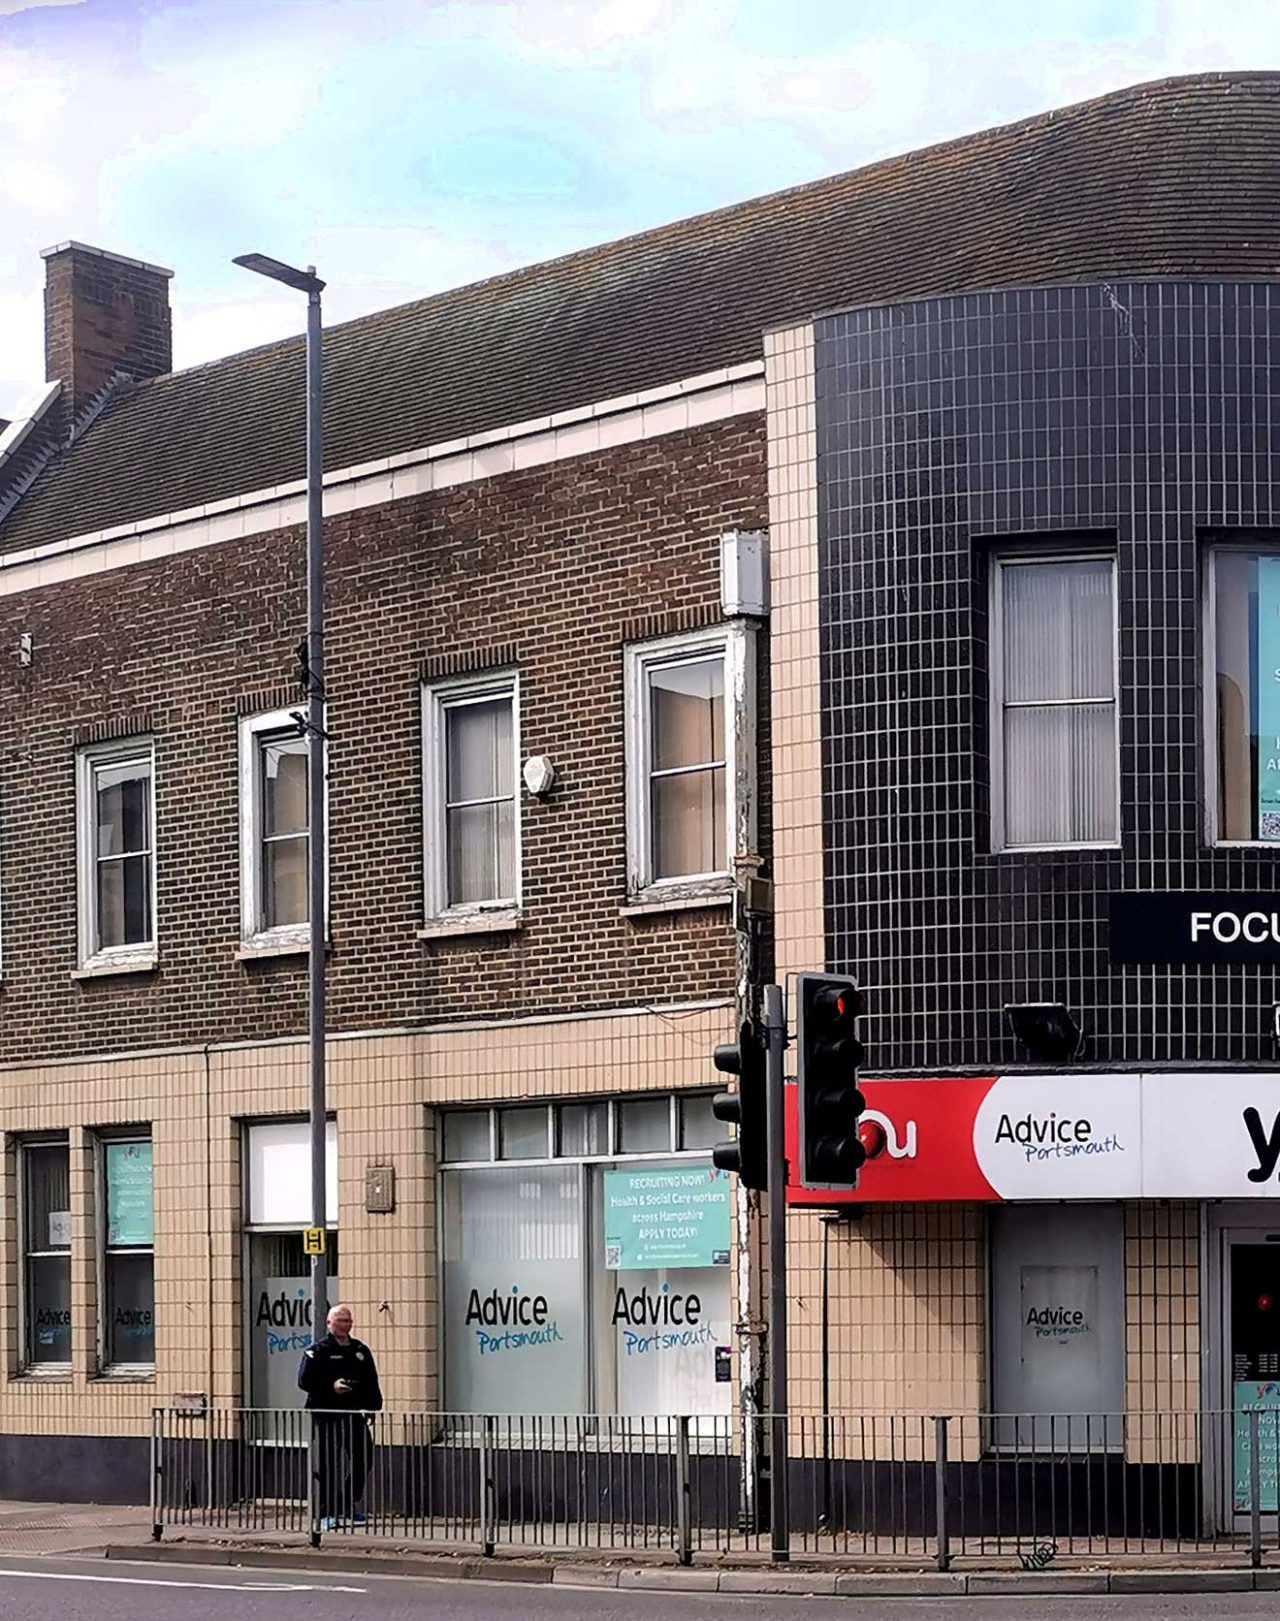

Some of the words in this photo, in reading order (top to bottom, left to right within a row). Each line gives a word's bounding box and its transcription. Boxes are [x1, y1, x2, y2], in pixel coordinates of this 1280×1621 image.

[858, 1109, 917, 1159] ou
[994, 1112, 1092, 1143] Advice
[1021, 1134, 1125, 1162] Portsmouth
[629, 1175, 681, 1190] RECRUITING
[610, 1195, 638, 1207] Health
[646, 1193, 671, 1206] Social
[671, 1192, 691, 1204] Care
[692, 1191, 726, 1203] workers
[632, 1213, 659, 1223] across
[659, 1210, 704, 1223] Hampshire
[306, 1231, 322, 1250] H
[638, 1228, 666, 1241] APPLY
[667, 1227, 698, 1239] TODAY!
[465, 1286, 548, 1325] Advice
[612, 1283, 701, 1326] Advice
[1026, 1306, 1083, 1325] Advice
[476, 1321, 563, 1354] Portsmouth
[623, 1320, 718, 1356] Portsmouth
